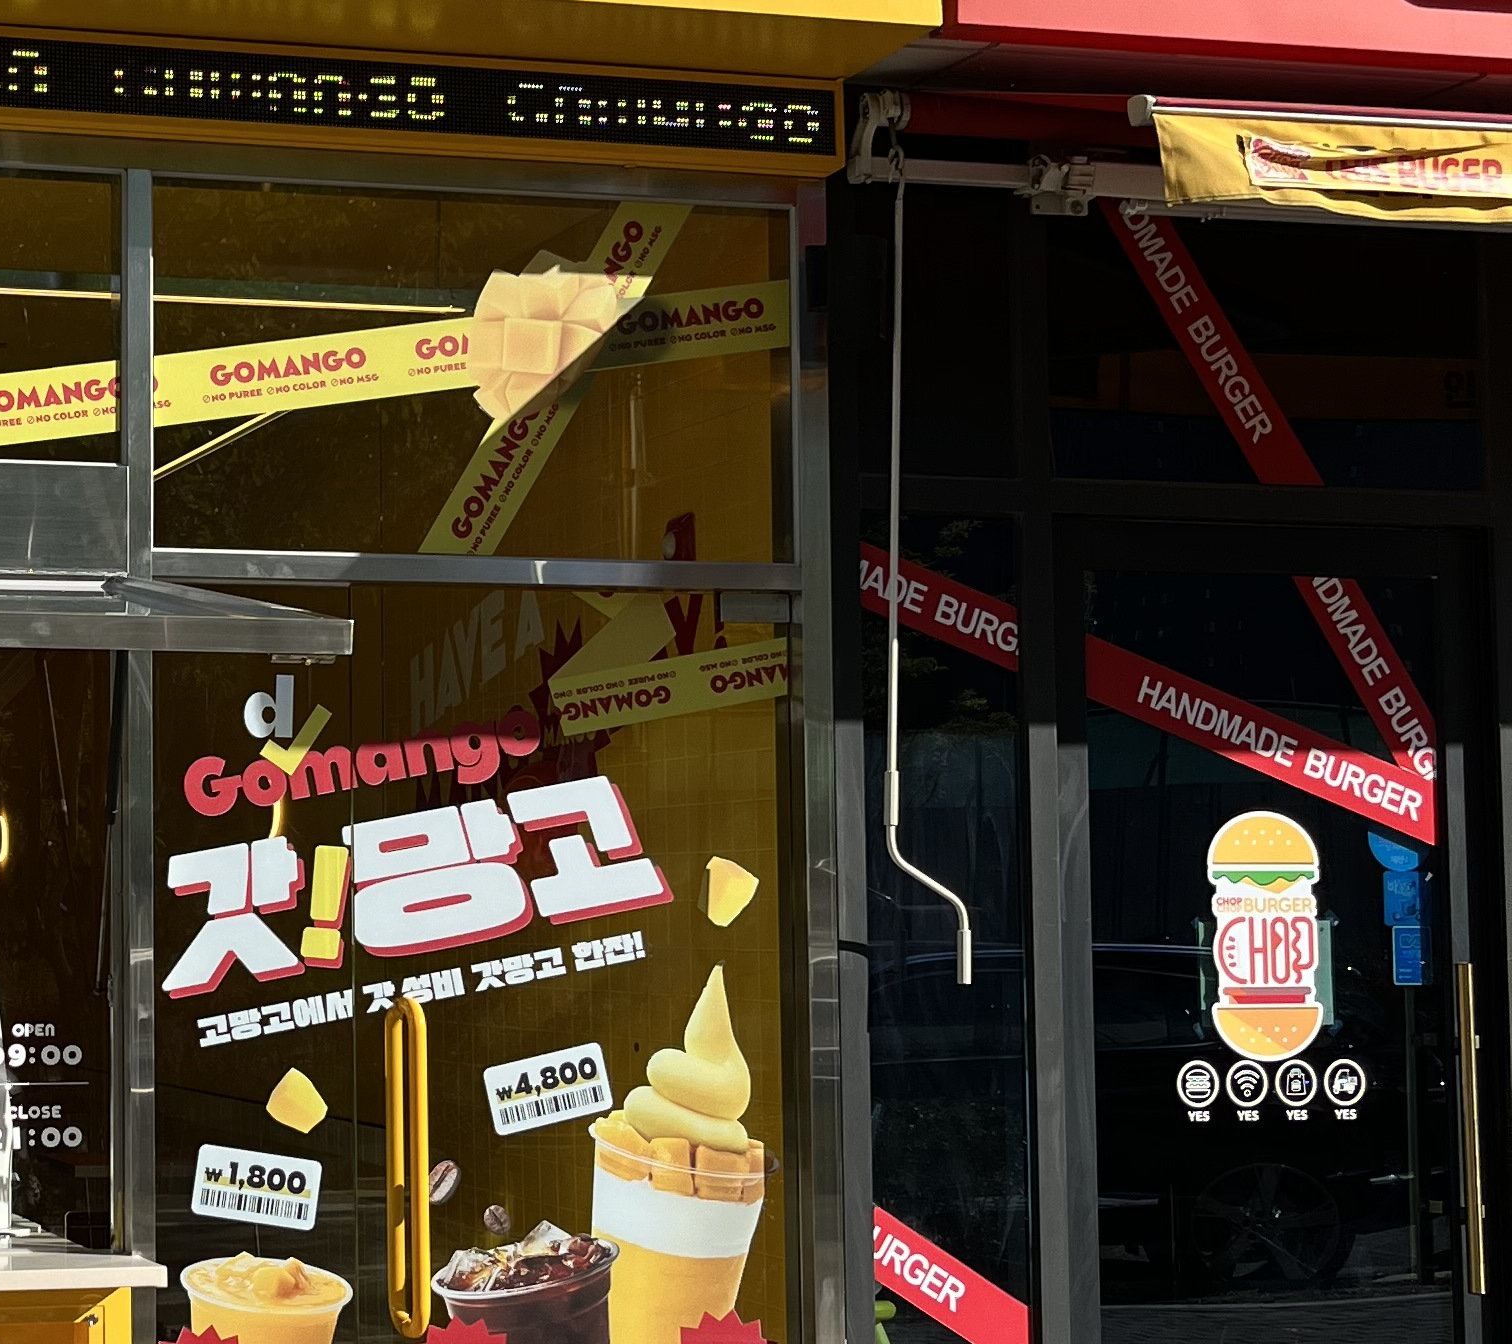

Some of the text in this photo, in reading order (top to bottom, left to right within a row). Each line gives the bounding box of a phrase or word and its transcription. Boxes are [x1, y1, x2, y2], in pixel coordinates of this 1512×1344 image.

[615, 297, 765, 336] GOMANGO
[210, 347, 366, 387] GOMANGO
[1187, 315, 1273, 444] BURGER
[211, 372, 379, 403] NO PUREE NO COLOR NO MSG
[35, 413, 51, 425] NO
[54, 409, 89, 423] COLOR
[102, 405, 117, 417] NO
[934, 594, 1019, 655] BURG
[1137, 675, 1423, 822] HANDMADE BURGER
[1378, 686, 1437, 781] BURG
[184, 710, 541, 817] Gomango
[1244, 896, 1313, 914] BURGER
[197, 988, 354, 1049] 고망고에서
[471, 947, 566, 993] 갓망고
[571, 930, 646, 972] 한잔!
[11, 1022, 55, 1038] OPEN
[8, 1104, 62, 1120] CLOSE
[1188, 1110, 1211, 1122] YES
[1236, 1110, 1260, 1122] YES
[1285, 1109, 1309, 1121] YES
[1334, 1108, 1357, 1120] YES
